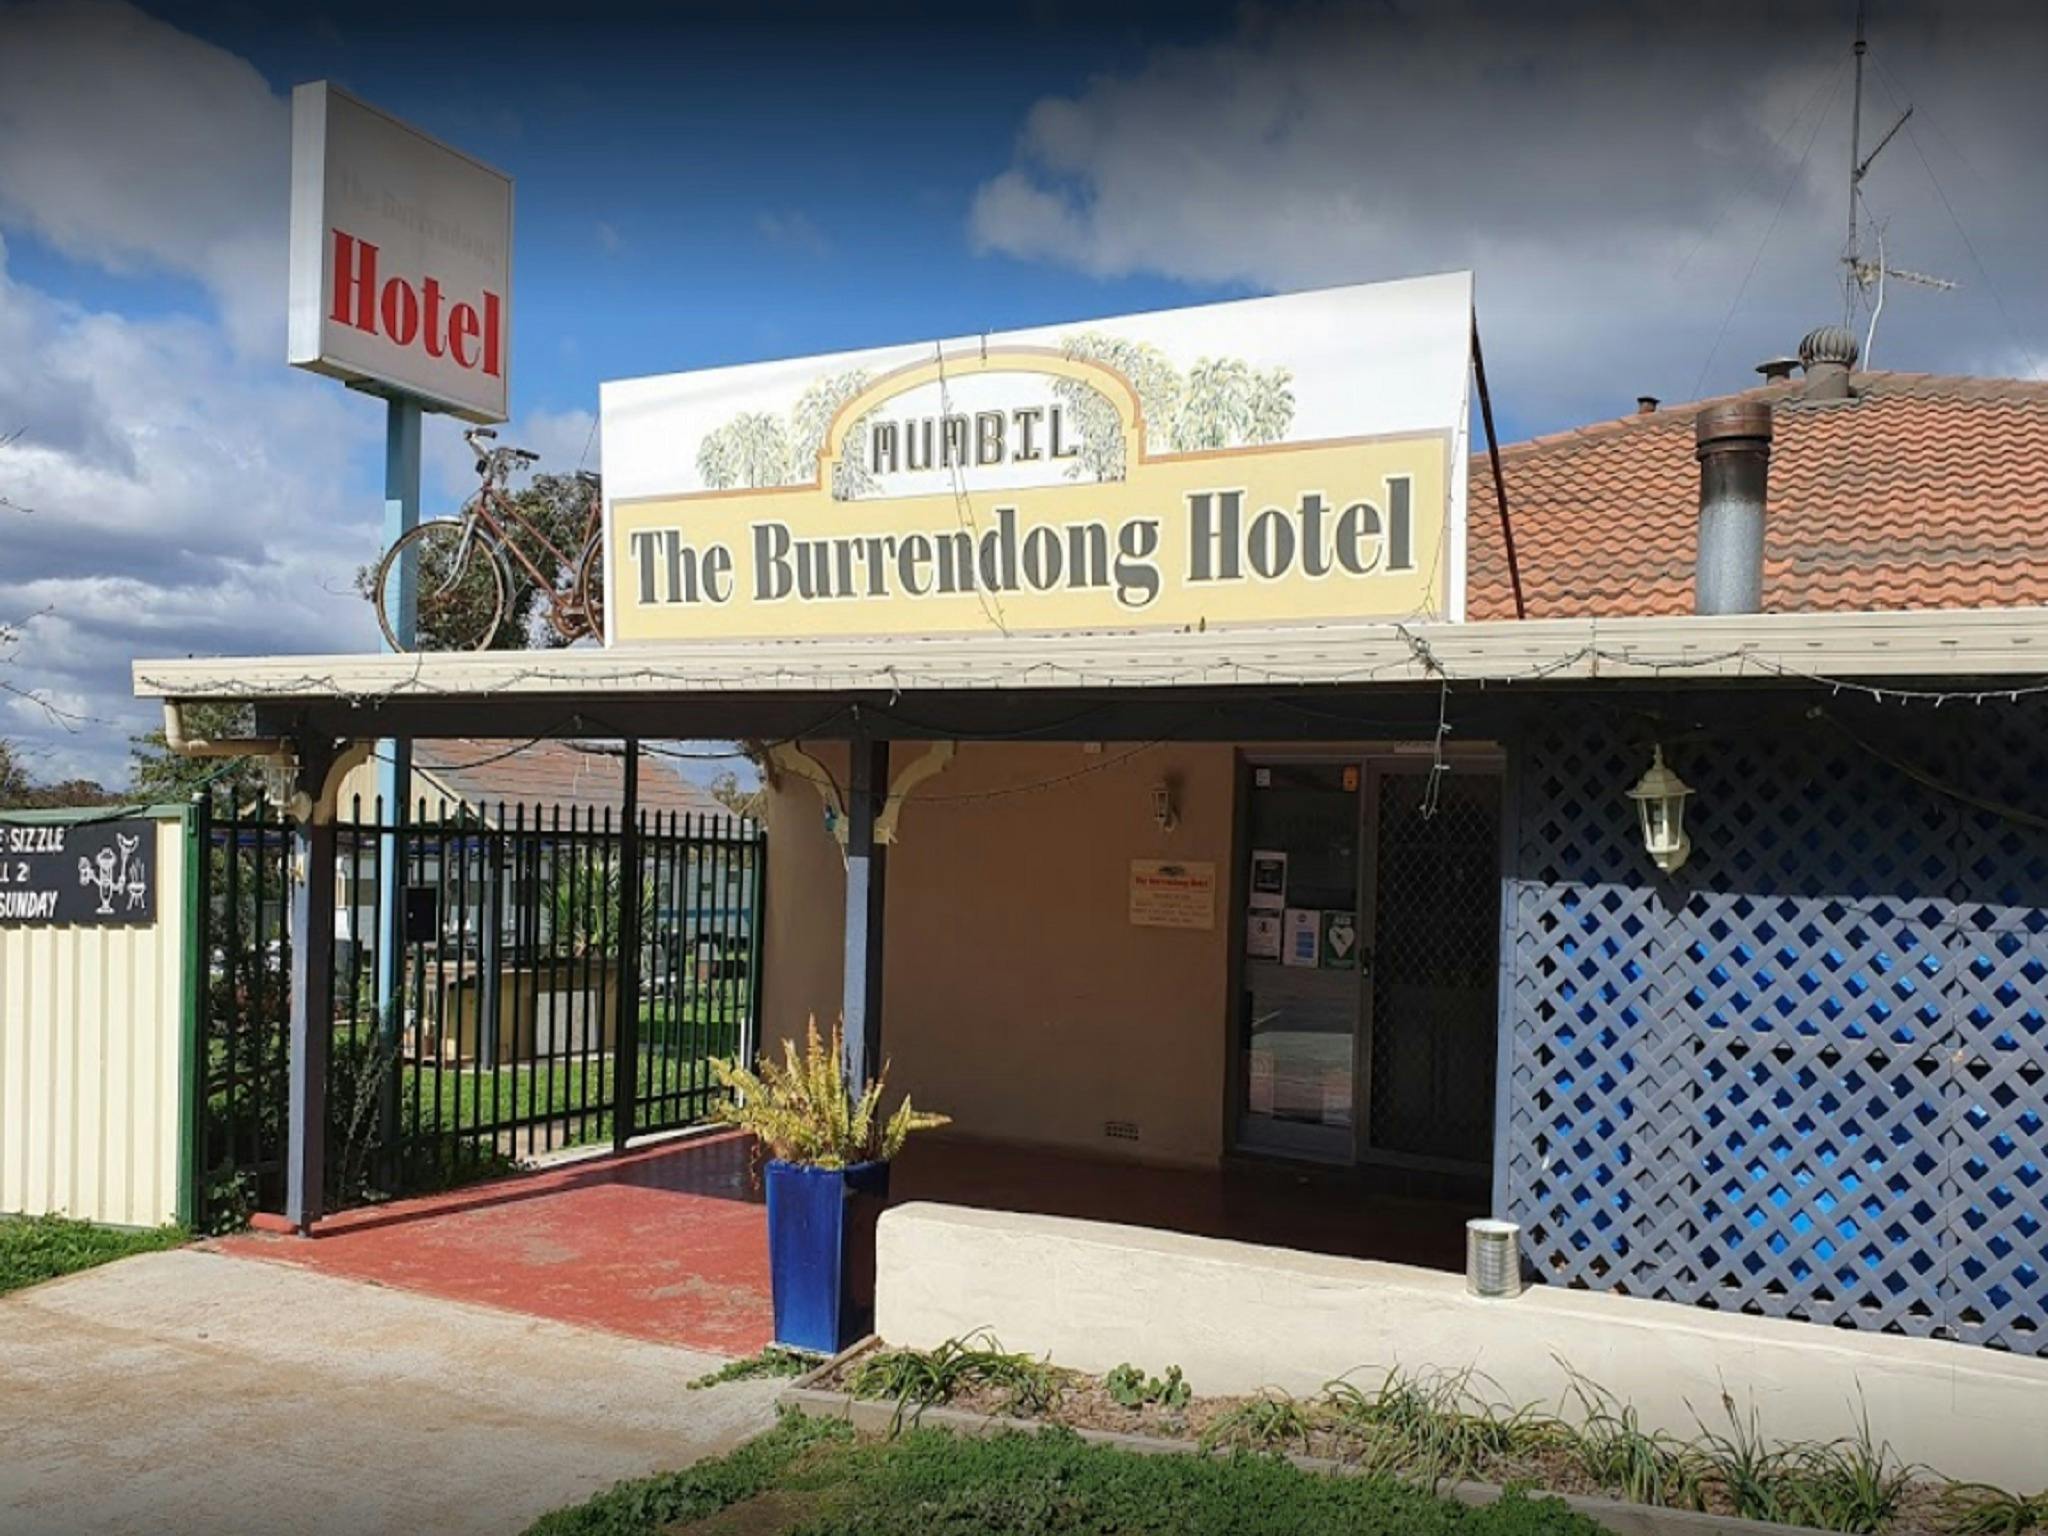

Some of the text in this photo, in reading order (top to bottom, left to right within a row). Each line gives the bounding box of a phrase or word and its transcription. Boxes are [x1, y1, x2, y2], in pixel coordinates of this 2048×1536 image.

[329, 227, 501, 378] Hotel
[872, 404, 1081, 475] MUMBIL
[630, 476, 1414, 608] The Burrendong Hotel
[10, 826, 65, 853] SIZZLE
[16, 861, 29, 883] 2
[0, 891, 58, 918] SUNDAY
